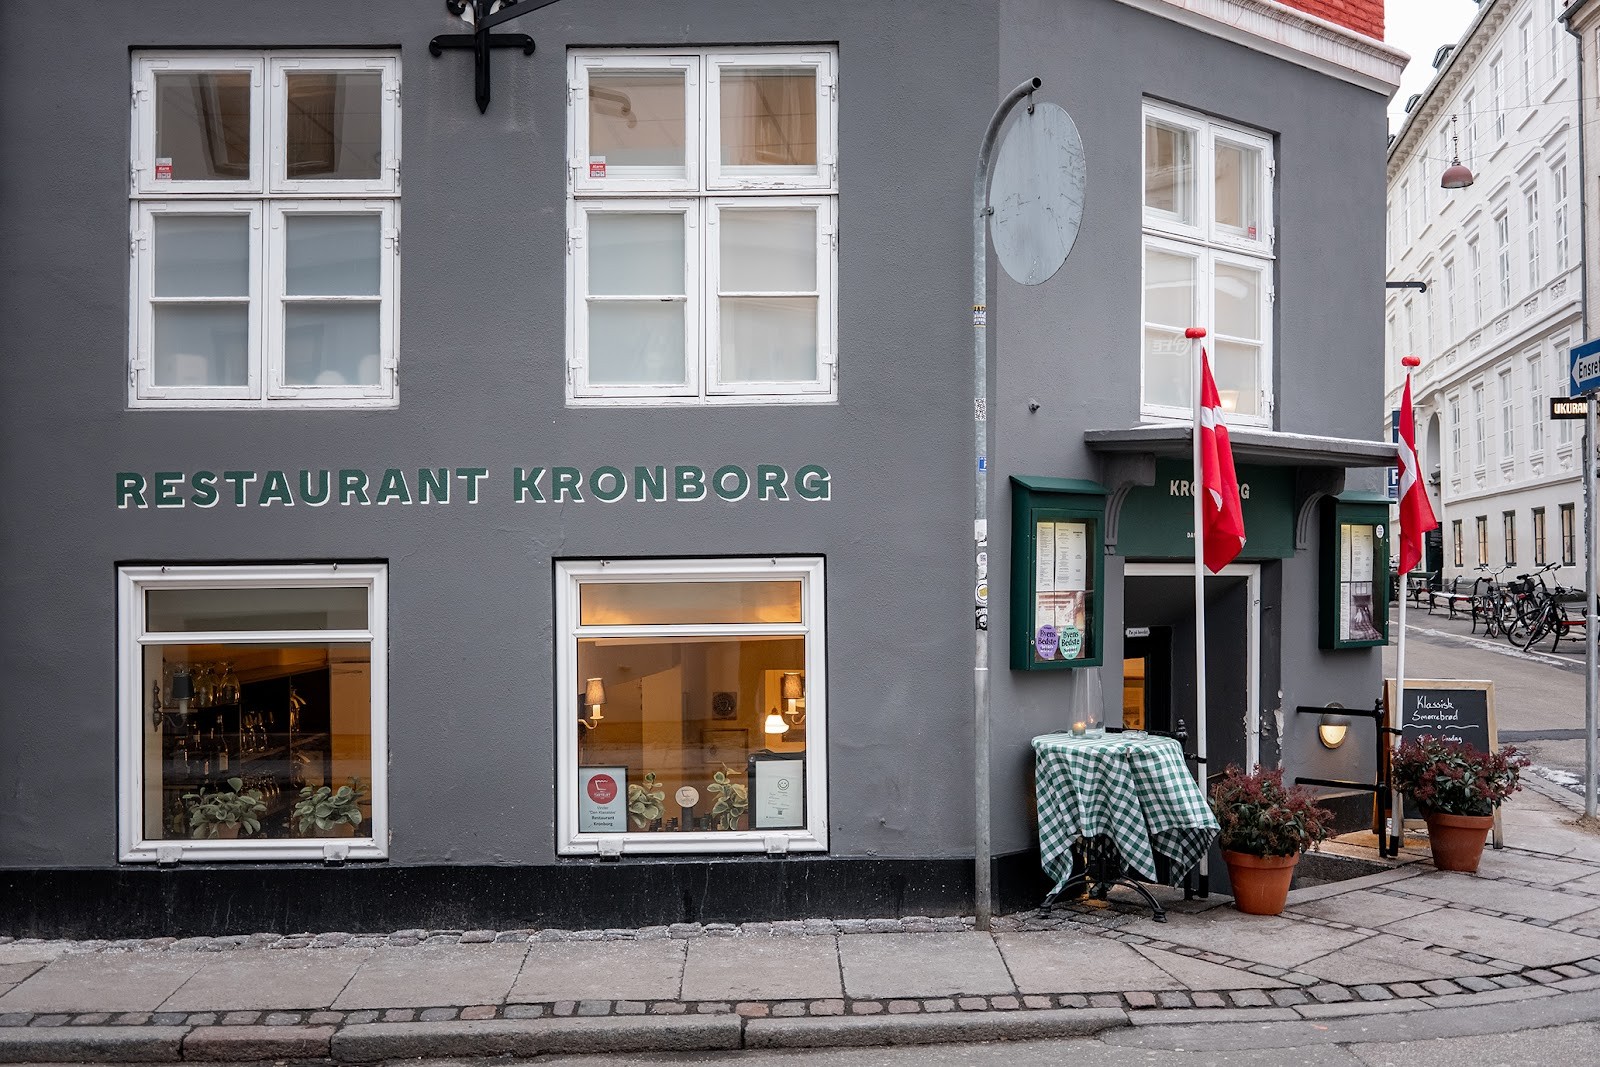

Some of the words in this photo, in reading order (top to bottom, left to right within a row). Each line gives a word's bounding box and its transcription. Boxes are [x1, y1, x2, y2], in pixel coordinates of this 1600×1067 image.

[116, 466, 489, 509] RESTAURANT
[514, 463, 831, 504] KRONBORG
[1416, 695, 1455, 709] Klassisk
